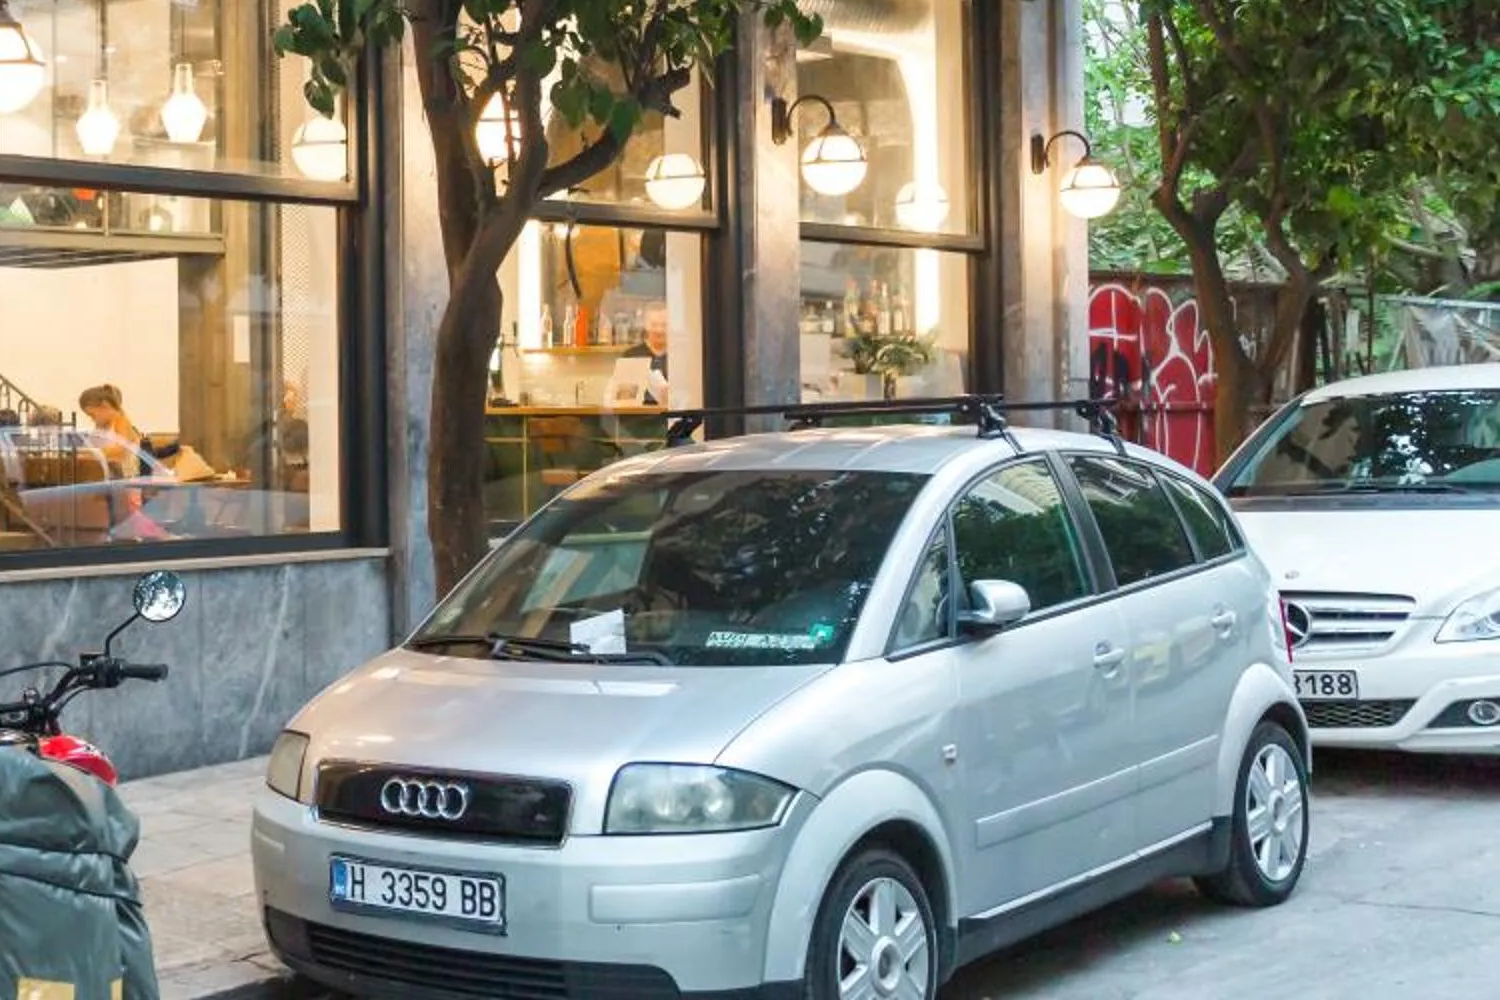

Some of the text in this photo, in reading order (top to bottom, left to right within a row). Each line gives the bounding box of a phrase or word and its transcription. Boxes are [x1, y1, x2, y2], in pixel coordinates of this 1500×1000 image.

[350, 866, 497, 918] H 3359 BB
